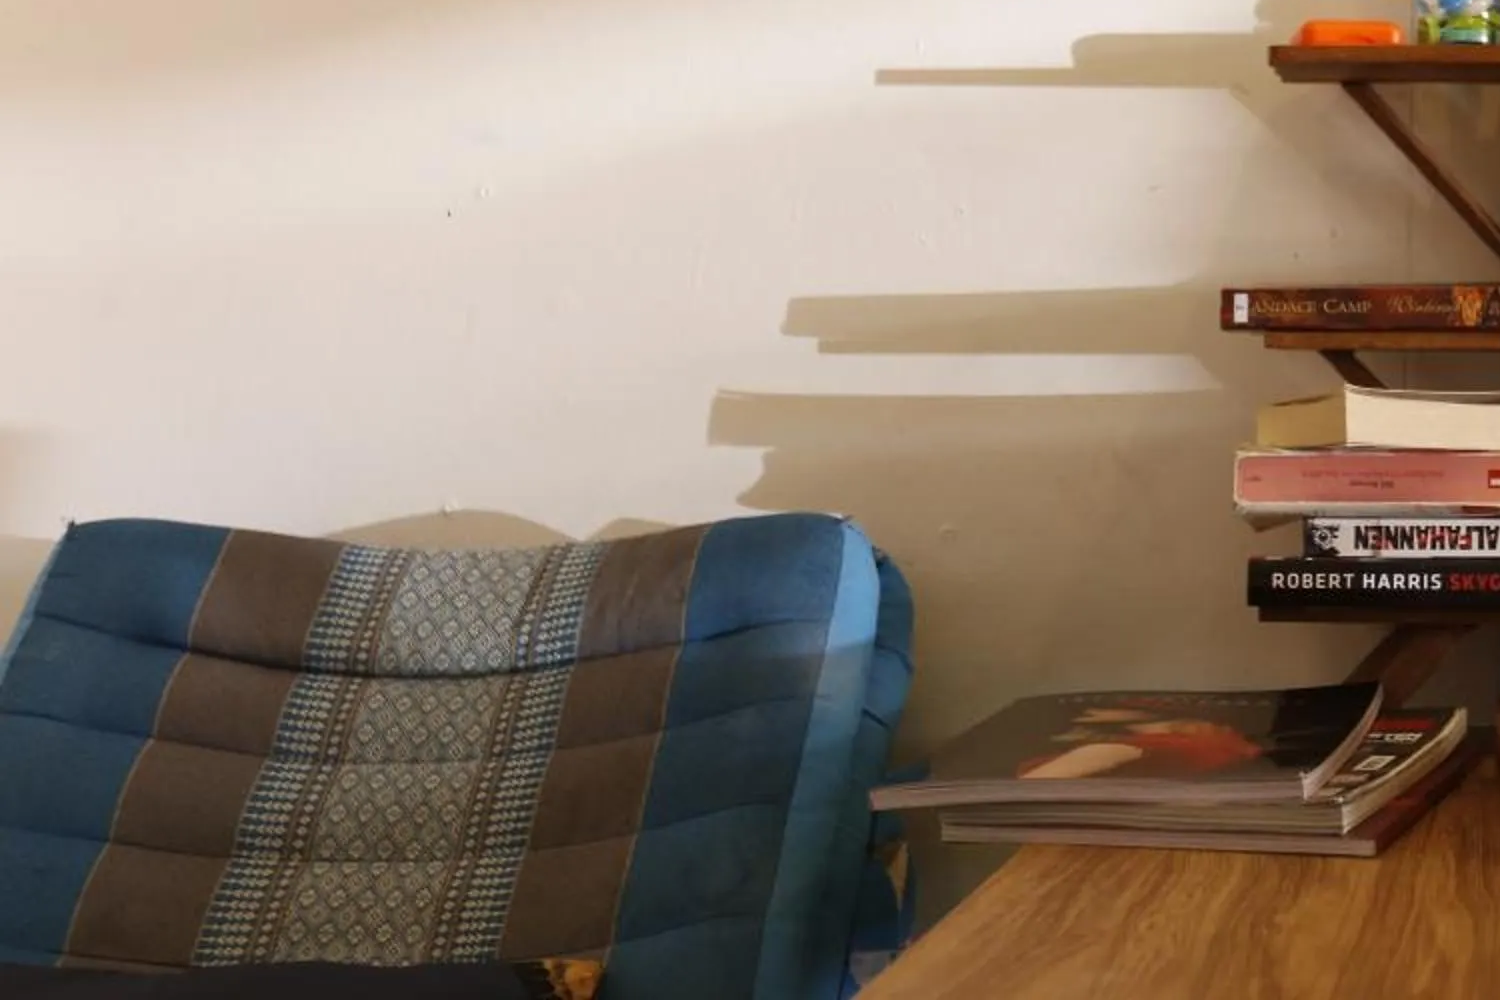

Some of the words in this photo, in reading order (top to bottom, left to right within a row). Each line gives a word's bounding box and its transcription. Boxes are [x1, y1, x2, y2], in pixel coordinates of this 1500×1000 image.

[1248, 298, 1318, 315] ANDACE
[1323, 298, 1373, 315] CAMP
[1353, 524, 1500, 551] ALFAHANNEN
[1271, 572, 1355, 590] ROBERT
[1362, 572, 1443, 590] HARRIS
